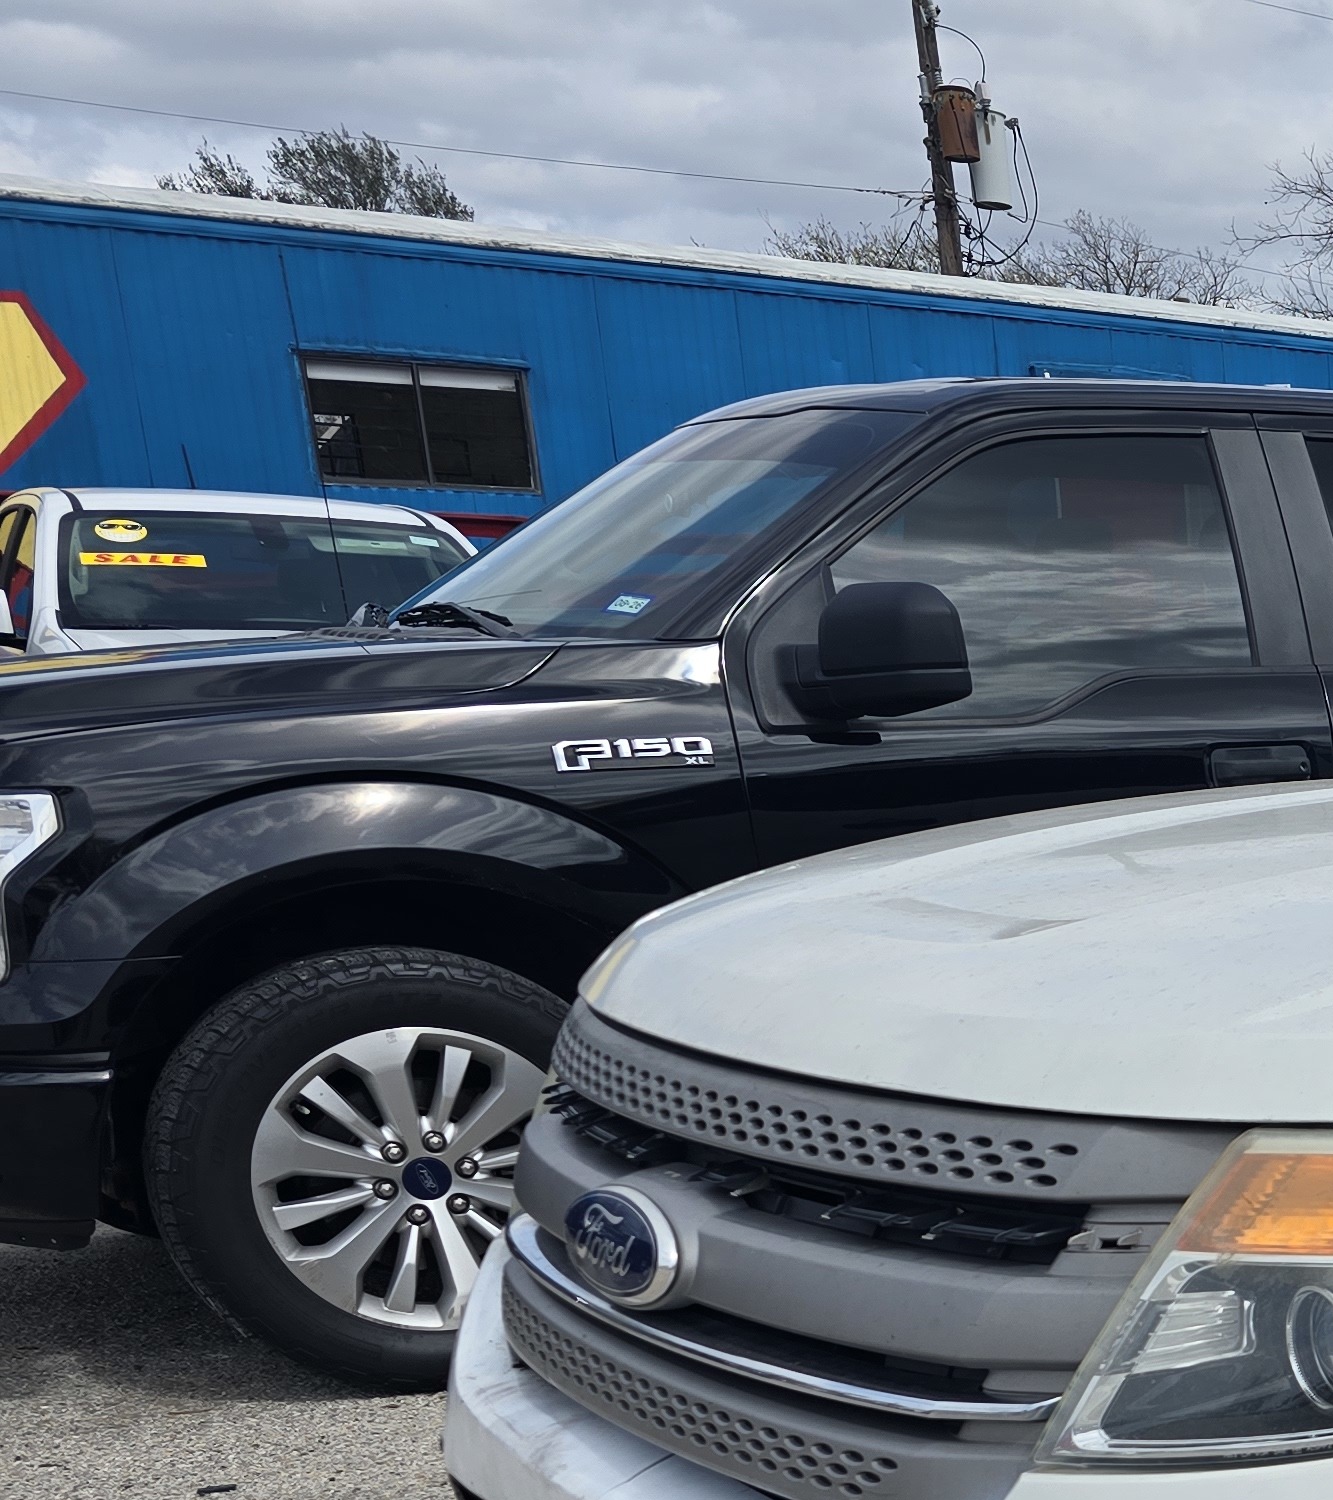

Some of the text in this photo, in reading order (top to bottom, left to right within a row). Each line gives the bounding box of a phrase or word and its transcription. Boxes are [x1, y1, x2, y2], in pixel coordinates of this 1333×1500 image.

[94, 553, 191, 564] SALE
[684, 756, 709, 765] XL
[576, 1203, 635, 1277] Ford
